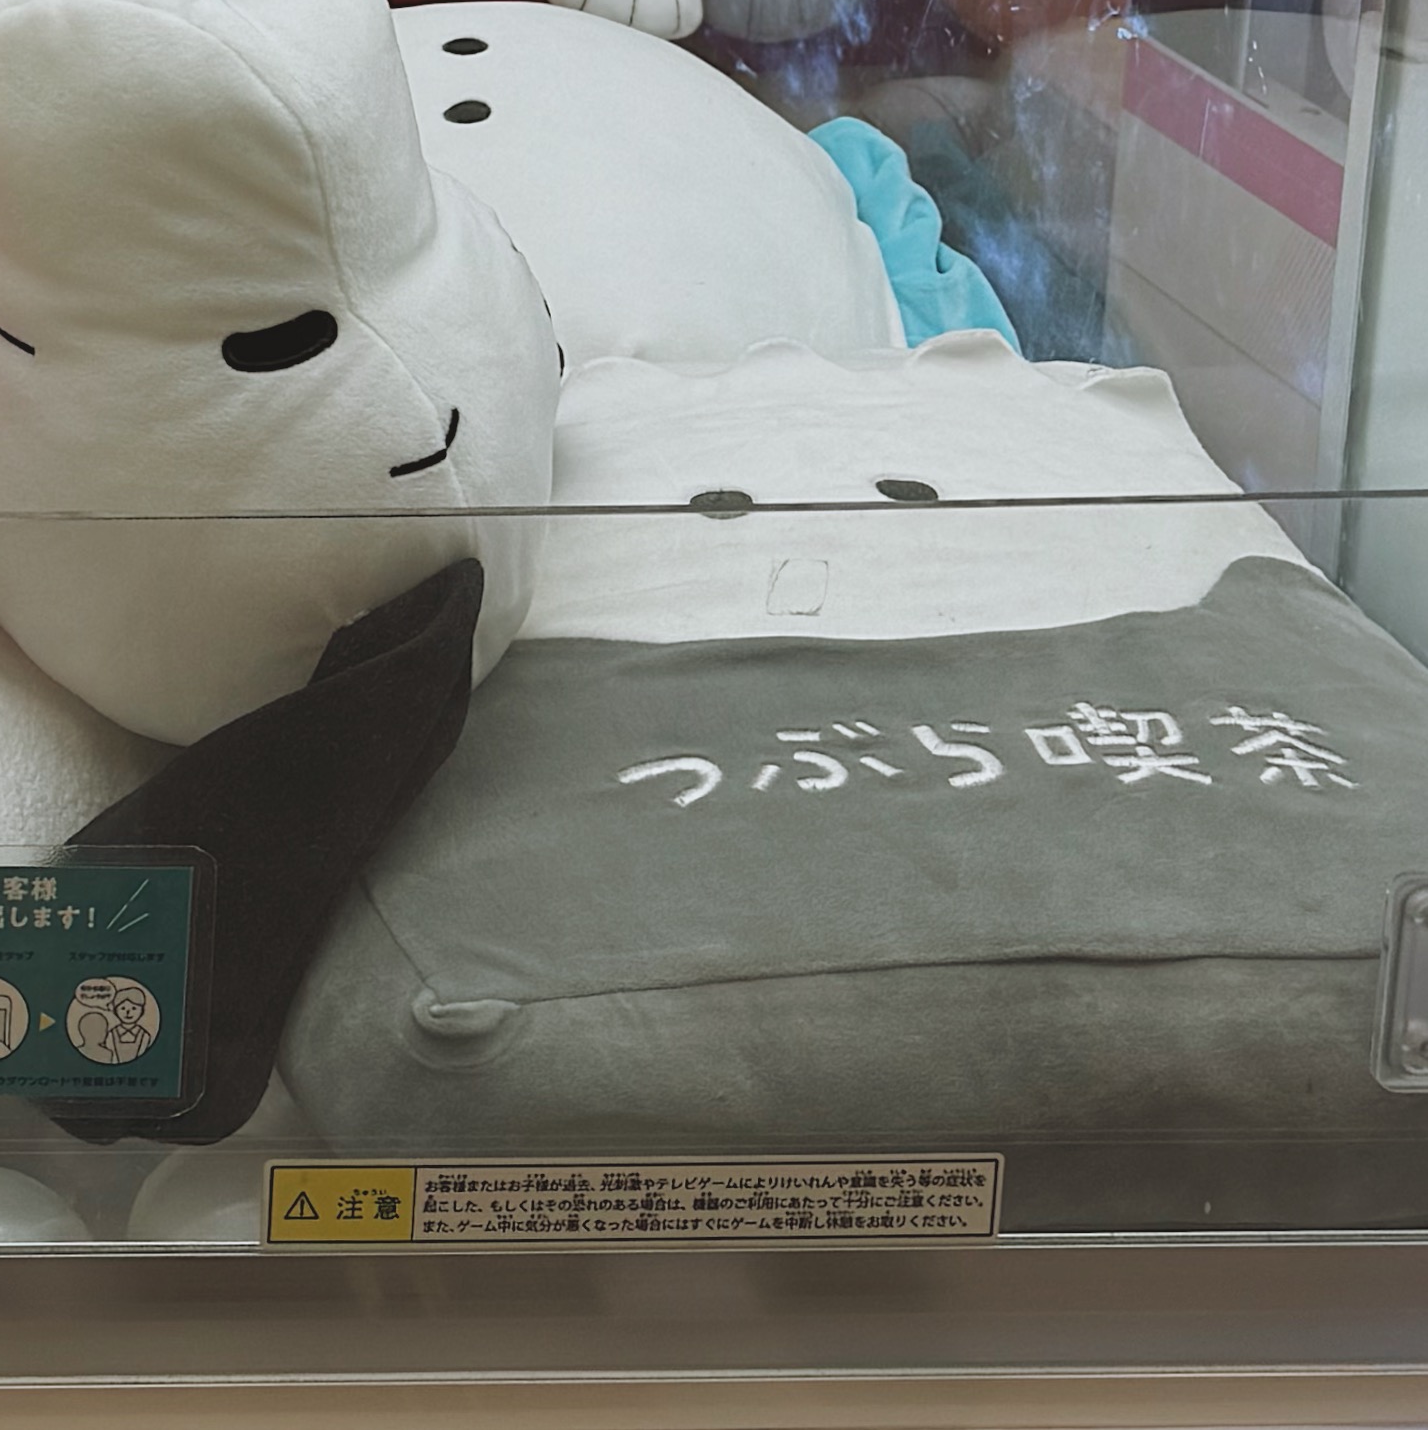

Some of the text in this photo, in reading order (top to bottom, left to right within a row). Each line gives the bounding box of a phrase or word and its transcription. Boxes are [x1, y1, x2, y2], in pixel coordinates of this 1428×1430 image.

[616, 700, 1360, 808] つぶら喫茶
